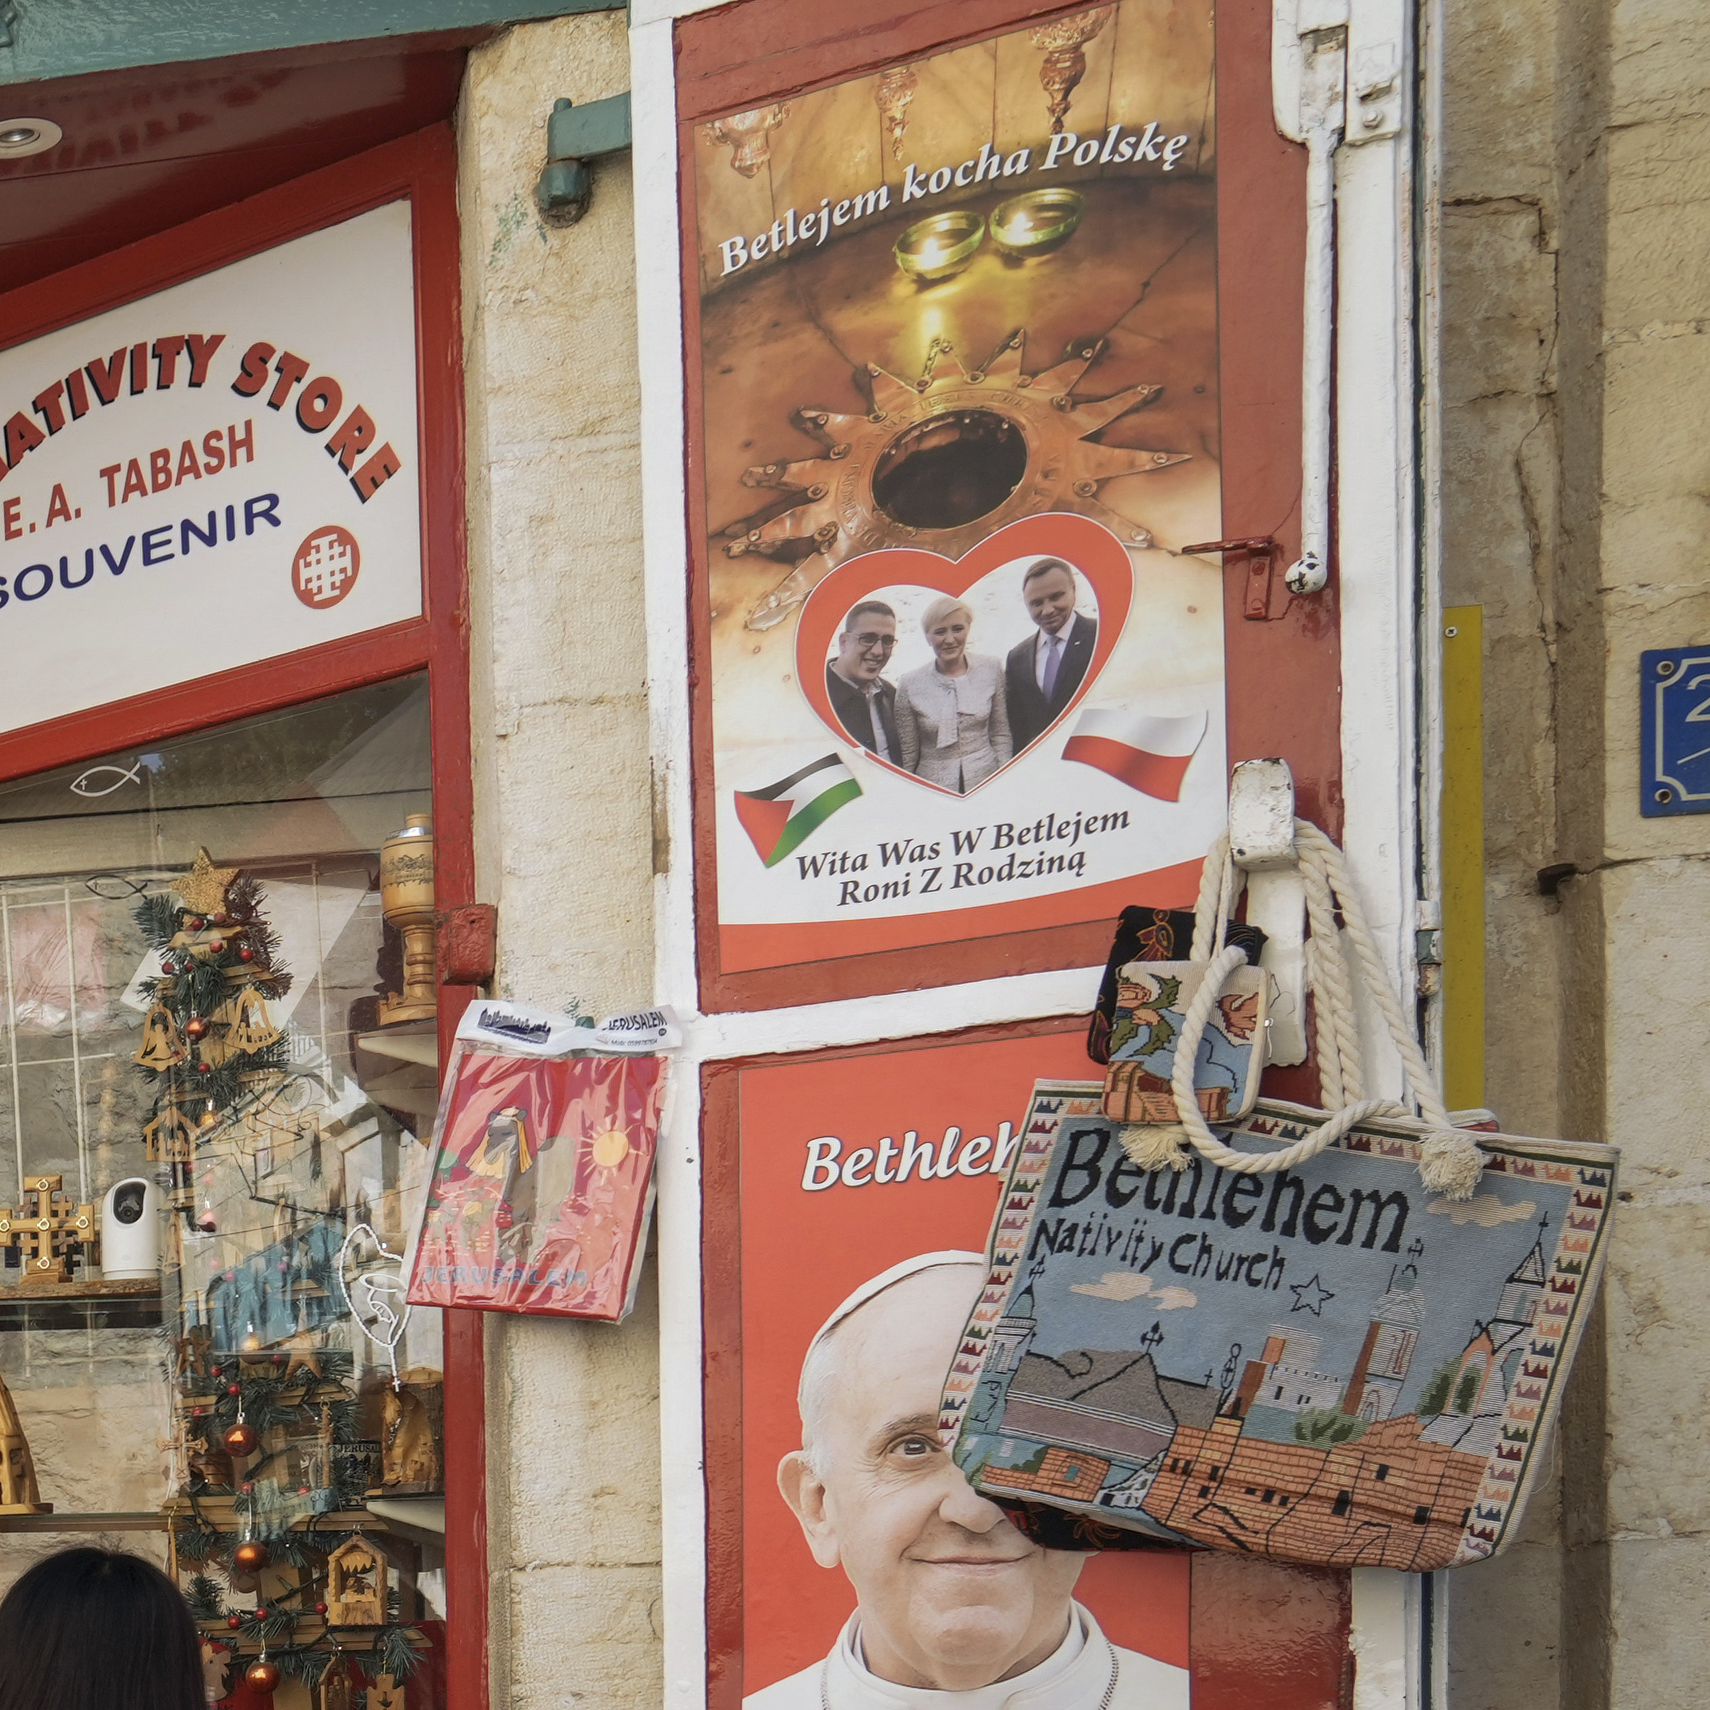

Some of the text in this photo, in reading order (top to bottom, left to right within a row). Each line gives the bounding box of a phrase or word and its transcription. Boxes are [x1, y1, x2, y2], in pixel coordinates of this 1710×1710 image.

[718, 123, 1189, 278] Betlejem kocha Polskę
[231, 342, 403, 504] STORE
[3, 419, 255, 542] E. A. TABASH
[797, 808, 1130, 882] Wita Was W Betlejem
[838, 850, 1086, 906] Roni Z Rodziną
[602, 1011, 668, 1032] JERUSALEM
[801, 1121, 1023, 1191] Bethleh
[420, 1265, 587, 1287] JERUSALEM
[1027, 1211, 1289, 1290] Nativity Church
